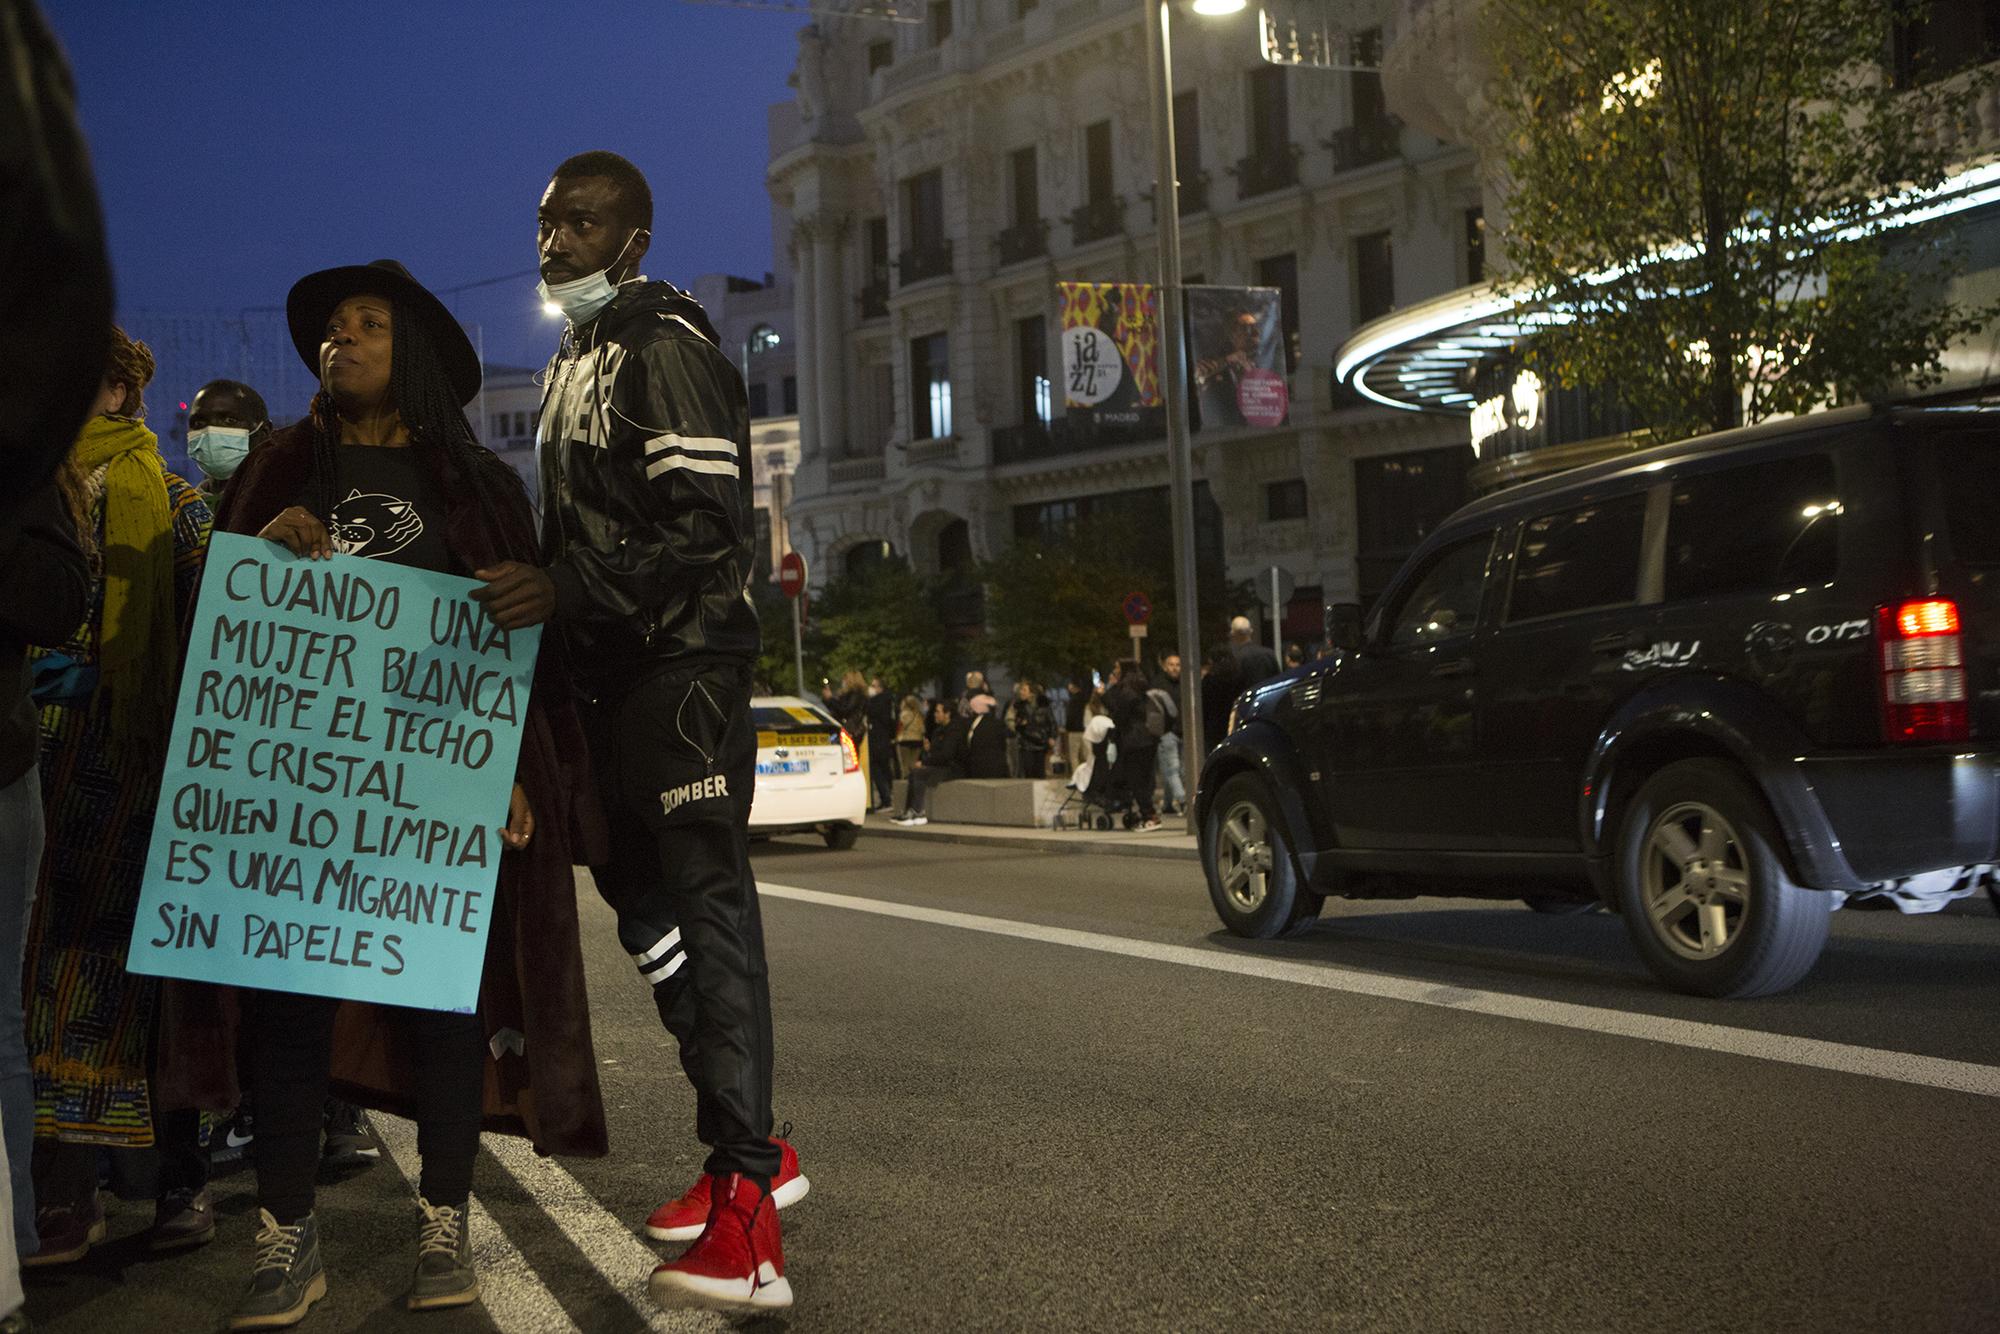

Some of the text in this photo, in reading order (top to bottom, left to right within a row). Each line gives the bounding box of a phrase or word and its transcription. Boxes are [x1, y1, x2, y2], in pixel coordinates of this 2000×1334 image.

[226, 558, 512, 662] CUANDO UNA
[211, 615, 517, 727] MUJER BLANCA
[196, 670, 493, 770] ROMPE EL TECHO
[187, 727, 418, 810] DE CRISTAL
[660, 774, 730, 816] BOMBER
[173, 783, 487, 868] QUIEN LO LIMPIA
[165, 840, 482, 933] ES UNA MIGRANTE
[243, 914, 404, 975] PAPELES
